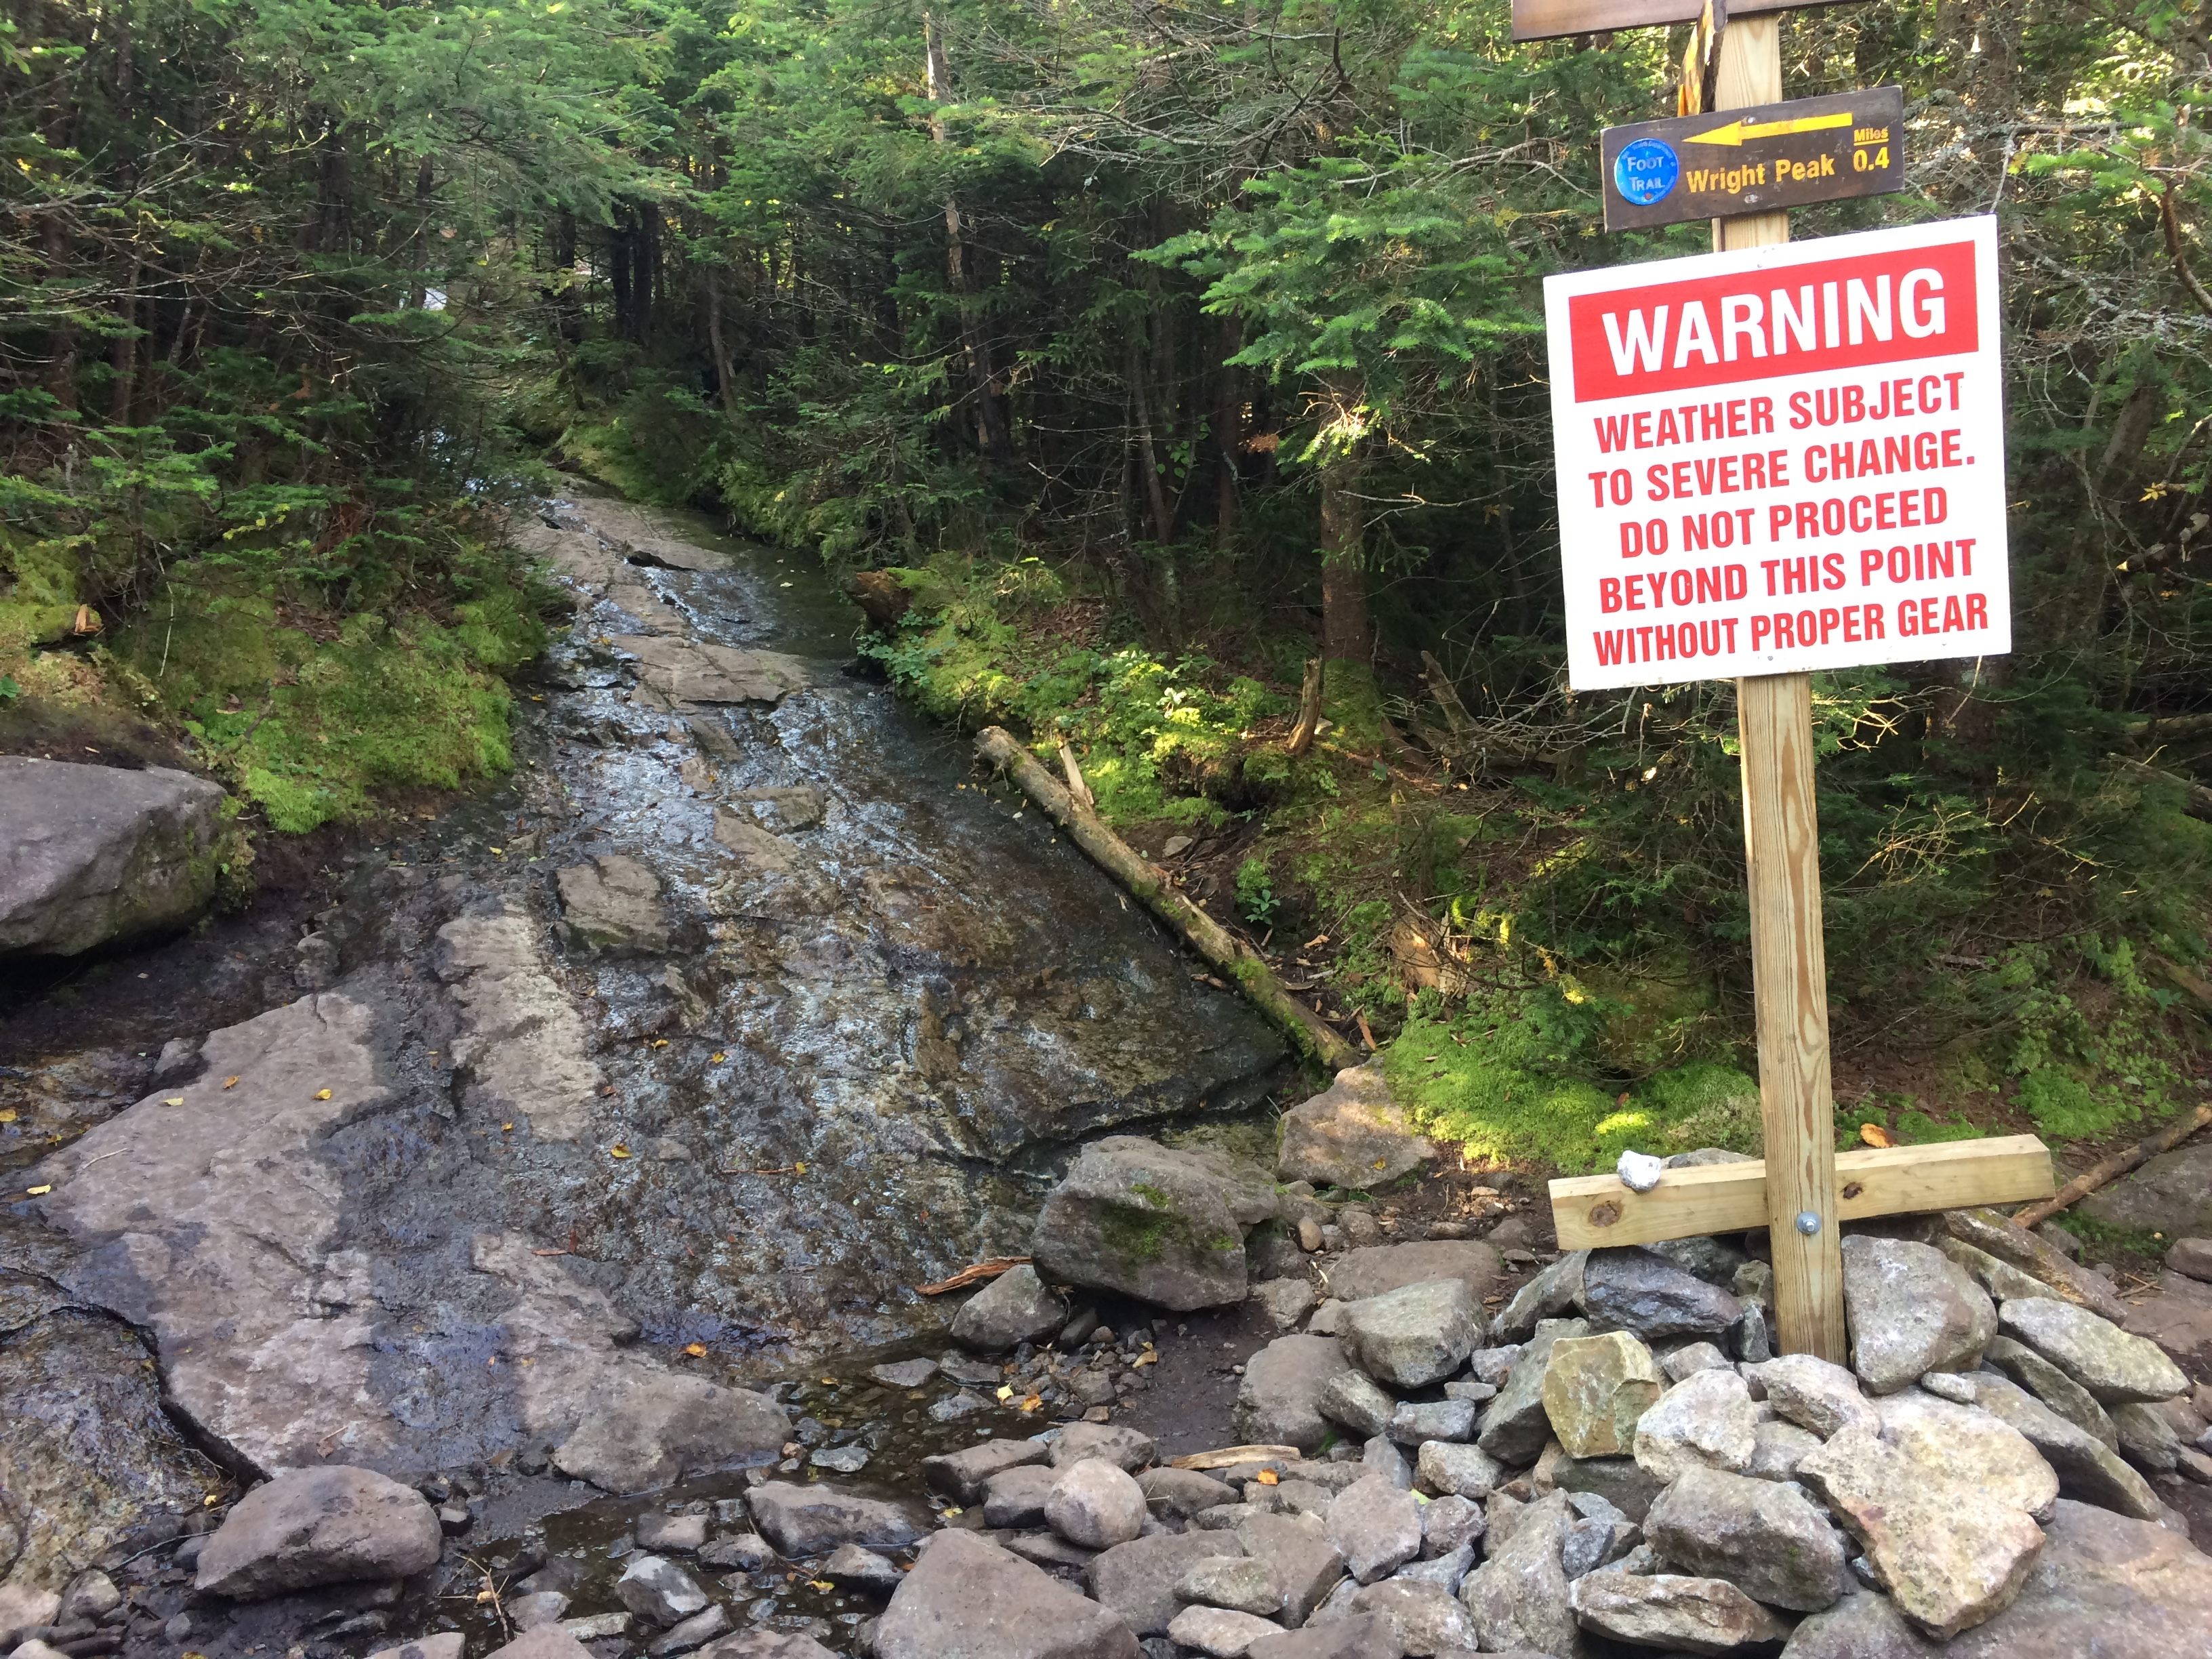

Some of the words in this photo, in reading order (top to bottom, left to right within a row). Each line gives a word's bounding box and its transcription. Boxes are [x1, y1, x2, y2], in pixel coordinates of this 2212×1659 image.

[1627, 156, 1664, 171] FOOT
[1685, 163, 1765, 194] Wright
[1775, 153, 1835, 183] Peak
[1853, 146, 1890, 172] 0.4
[1853, 127, 1889, 142] Miles
[1629, 176, 1666, 191] TRAIL
[1602, 268, 1946, 375] WARNING
[1594, 397, 1774, 453] WEATHER
[1789, 372, 1964, 430] SUBJECT
[1589, 468, 1633, 508] TO
[1647, 450, 1790, 501] SEVERE
[1805, 429, 1975, 483] CHANGE.
[1620, 519, 1668, 558] DO
[1683, 508, 1755, 552] NOT
[1769, 487, 1948, 542] PROCEED
[1600, 564, 1748, 614] BEYOND
[1761, 553, 1846, 596] THIS
[1861, 539, 1976, 586] POINT
[1594, 618, 1738, 666] WITHOUT
[1751, 604, 1885, 651] PROPER
[1898, 594, 1988, 637] GEAR
